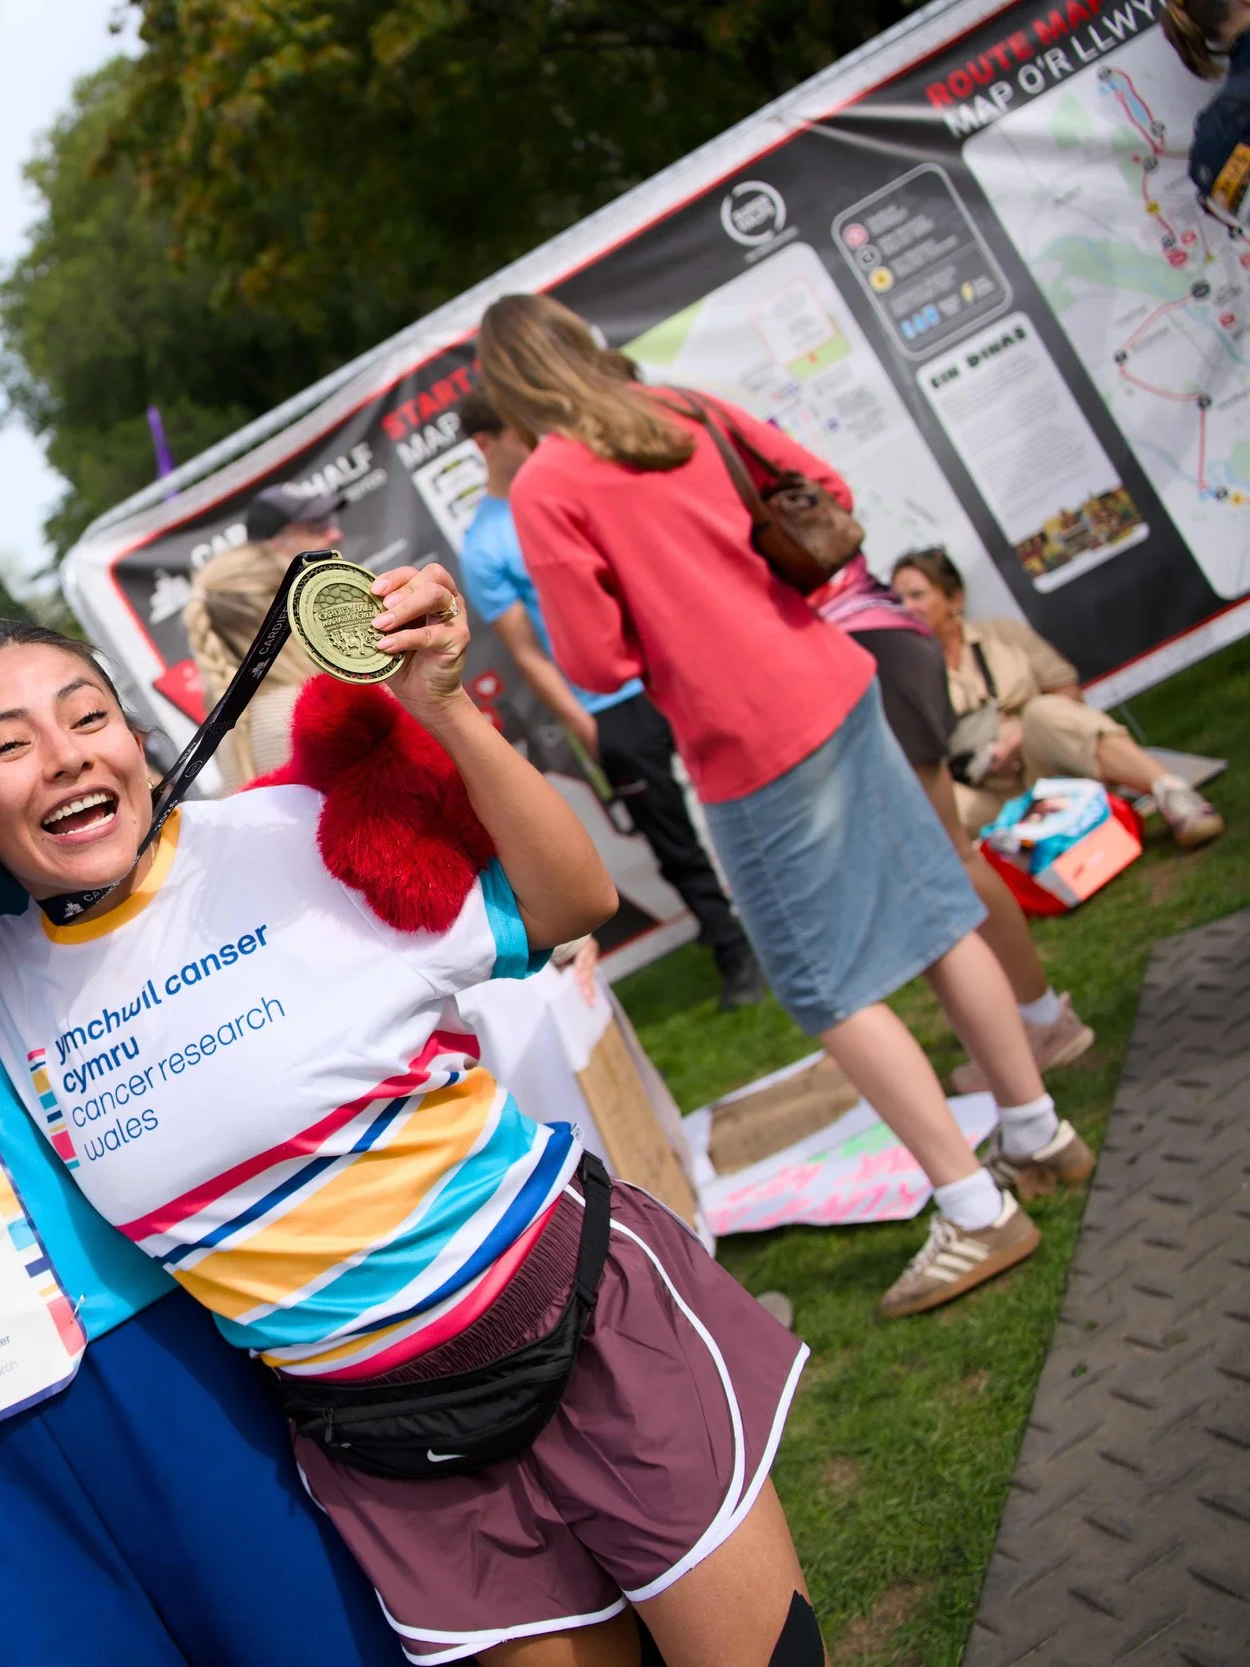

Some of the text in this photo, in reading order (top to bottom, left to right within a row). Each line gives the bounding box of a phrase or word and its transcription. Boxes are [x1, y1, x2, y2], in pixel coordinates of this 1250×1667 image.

[925, 29, 1035, 110] ROUTE
[942, 0, 1166, 139] MAP O'R LLWY
[381, 365, 472, 441] START
[395, 411, 461, 472] MAP
[318, 603, 374, 621] CARDIFF HALF
[322, 612, 360, 627] MARATHON
[55, 923, 268, 1065] ymchwil canser
[62, 1036, 140, 1094] cymru
[71, 996, 286, 1128] cancer research
[83, 1108, 159, 1161] wales
